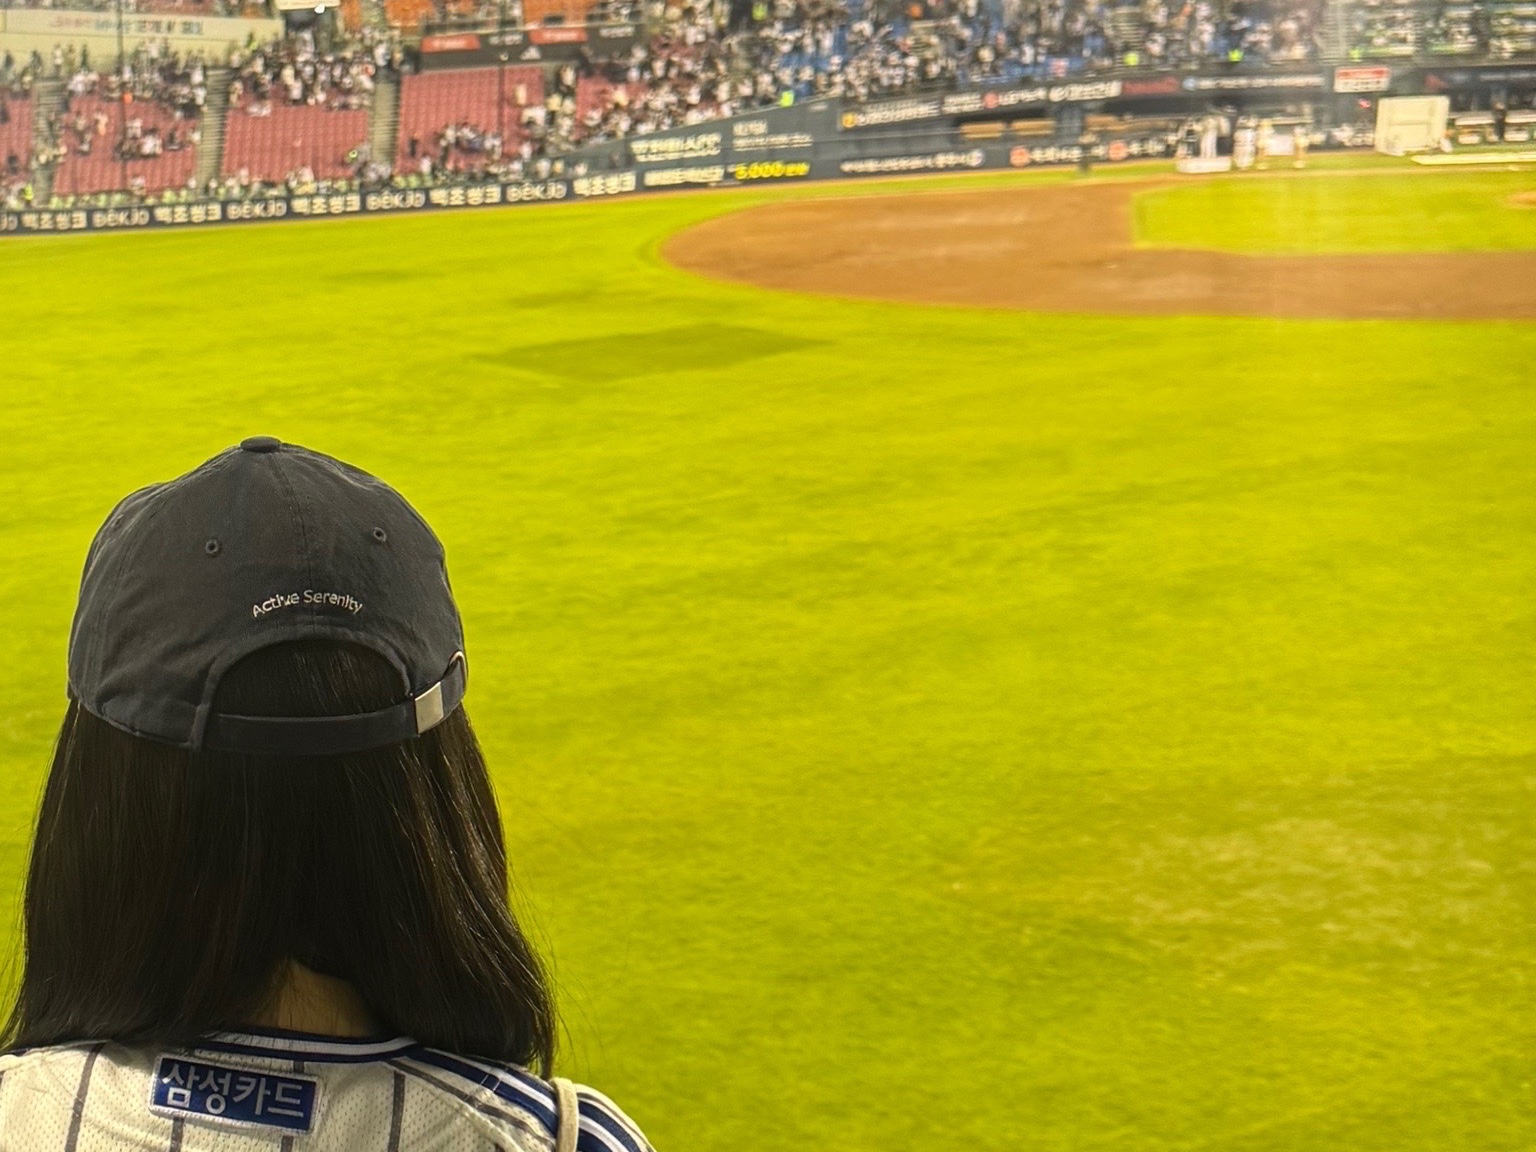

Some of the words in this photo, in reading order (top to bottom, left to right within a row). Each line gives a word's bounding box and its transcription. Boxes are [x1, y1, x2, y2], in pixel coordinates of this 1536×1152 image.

[252, 592, 300, 617] Active
[303, 589, 363, 615] Serenity
[162, 1063, 304, 1118] 삼성카드
